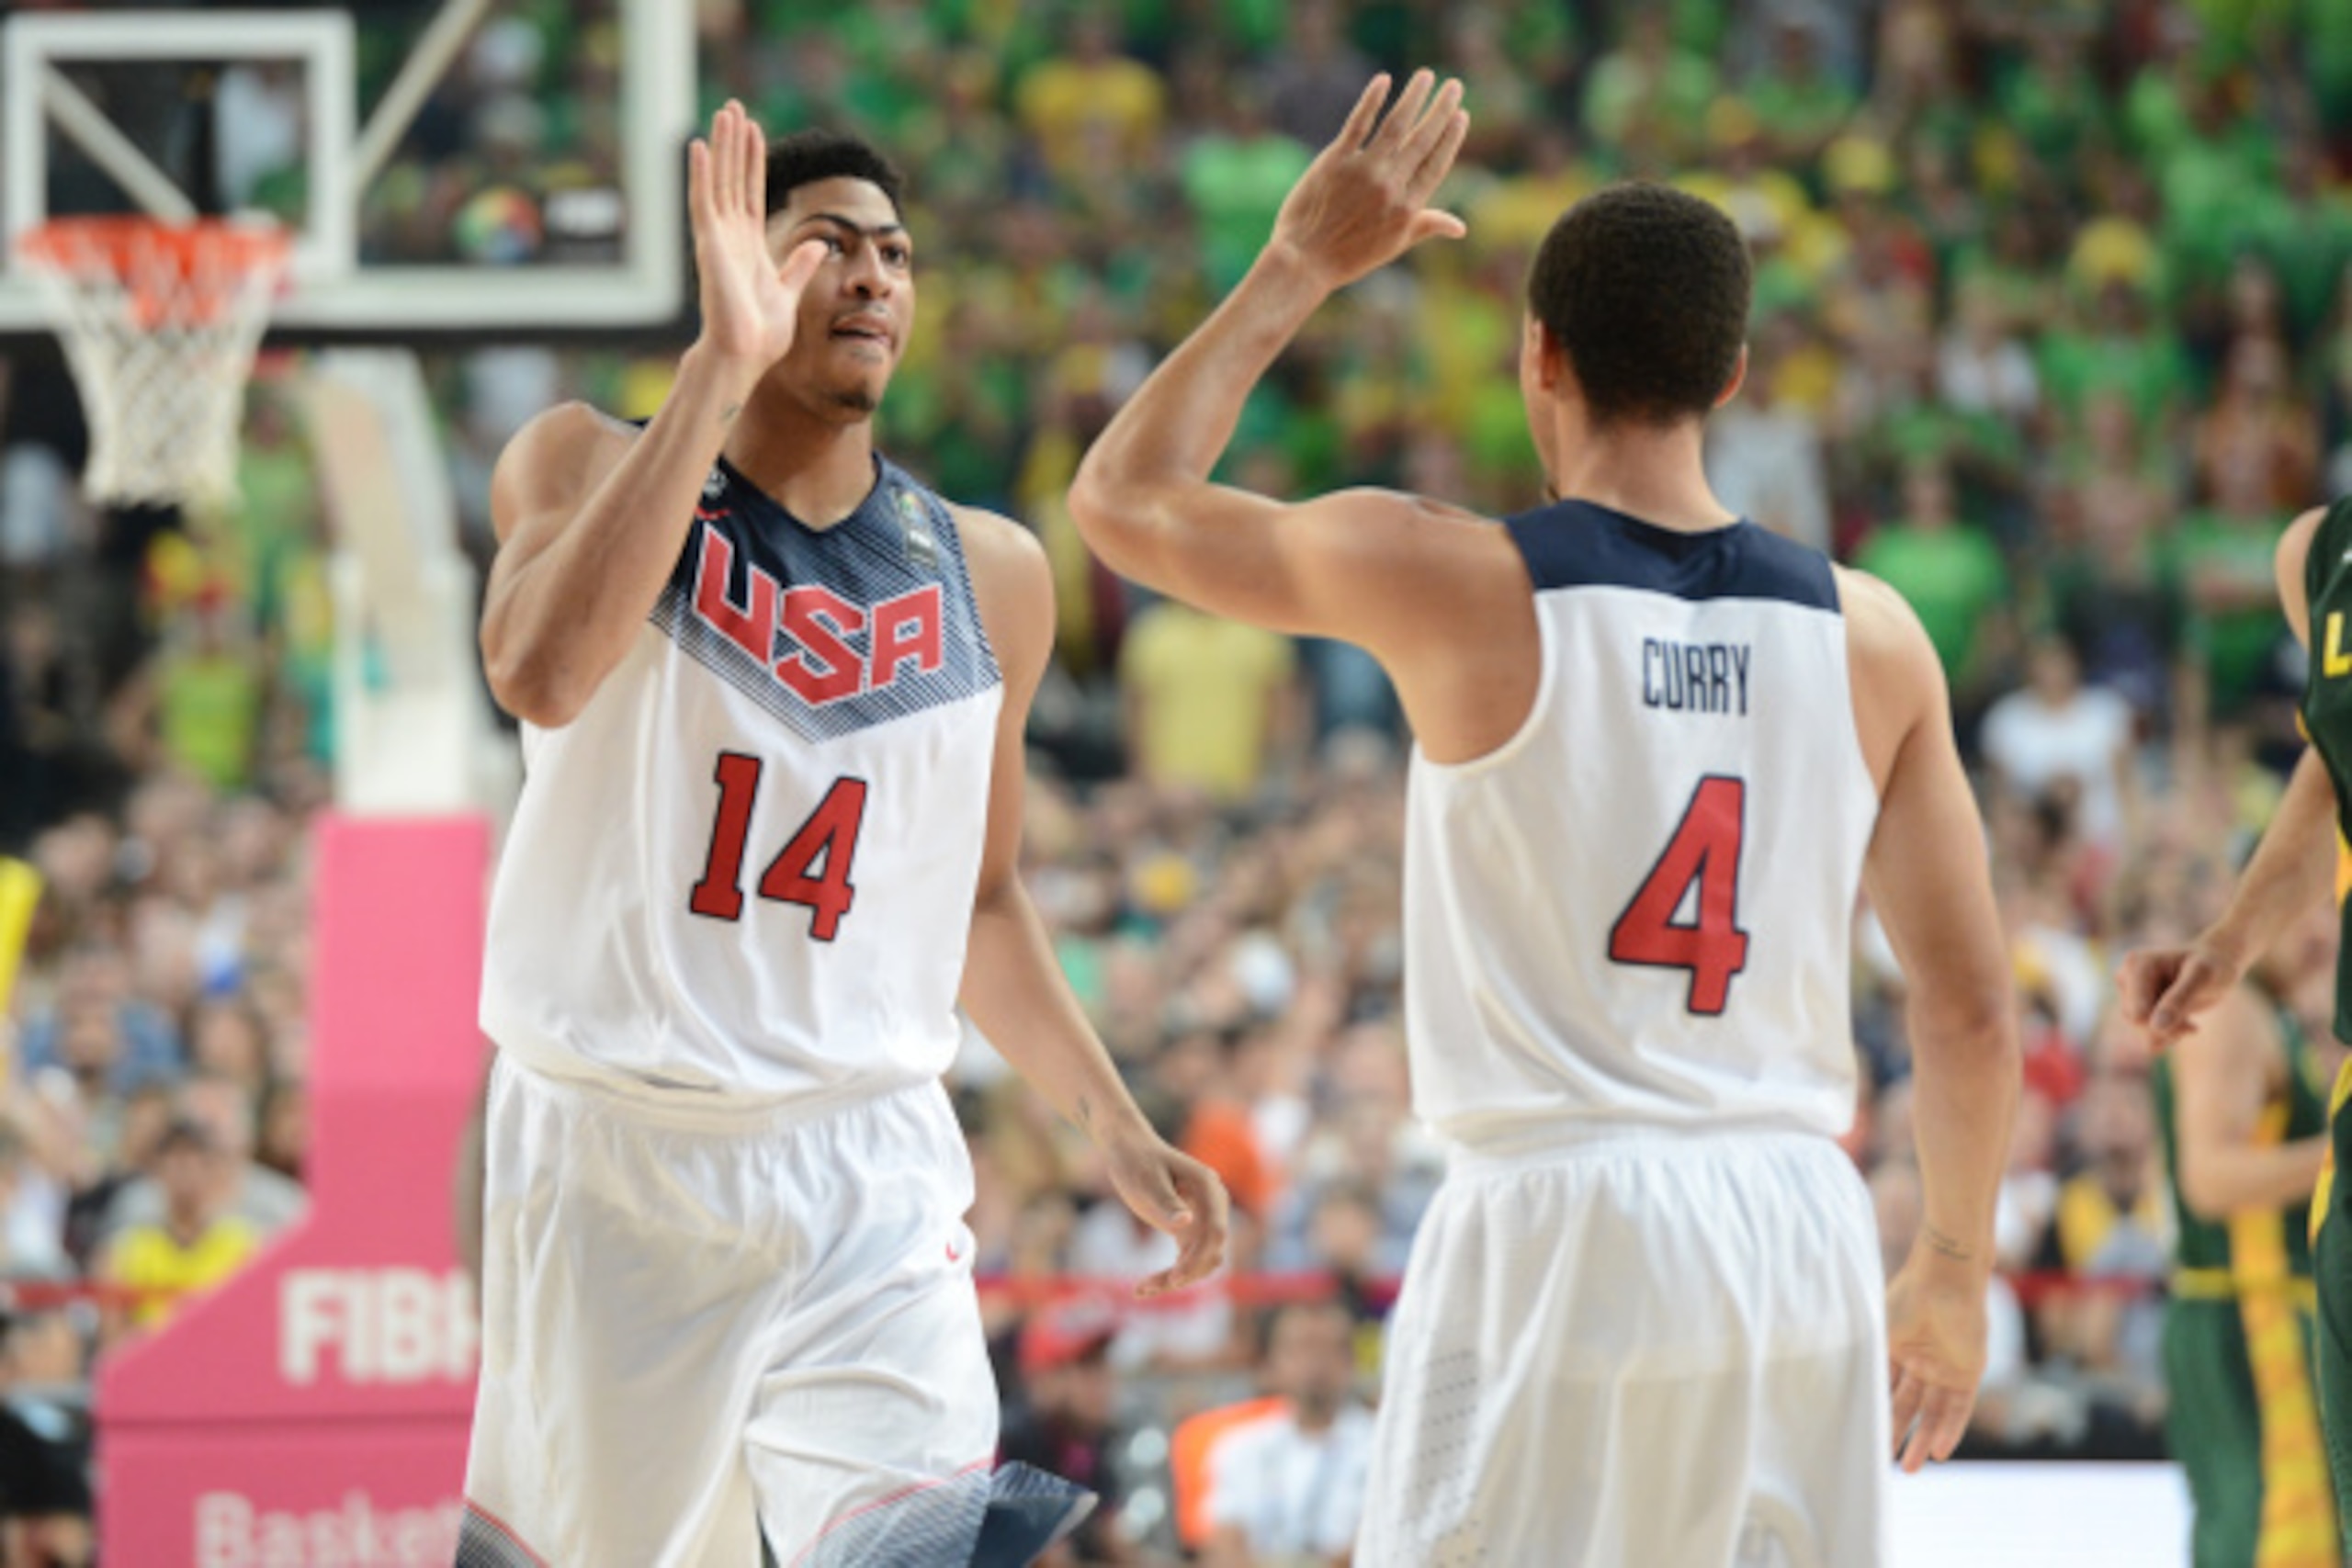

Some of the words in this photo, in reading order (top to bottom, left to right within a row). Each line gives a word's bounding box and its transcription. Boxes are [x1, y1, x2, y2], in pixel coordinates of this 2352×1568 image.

[693, 522, 944, 706] USA
[1642, 637, 1751, 715] CURRY
[689, 750, 867, 942] 14
[1608, 773, 1749, 1015] 4
